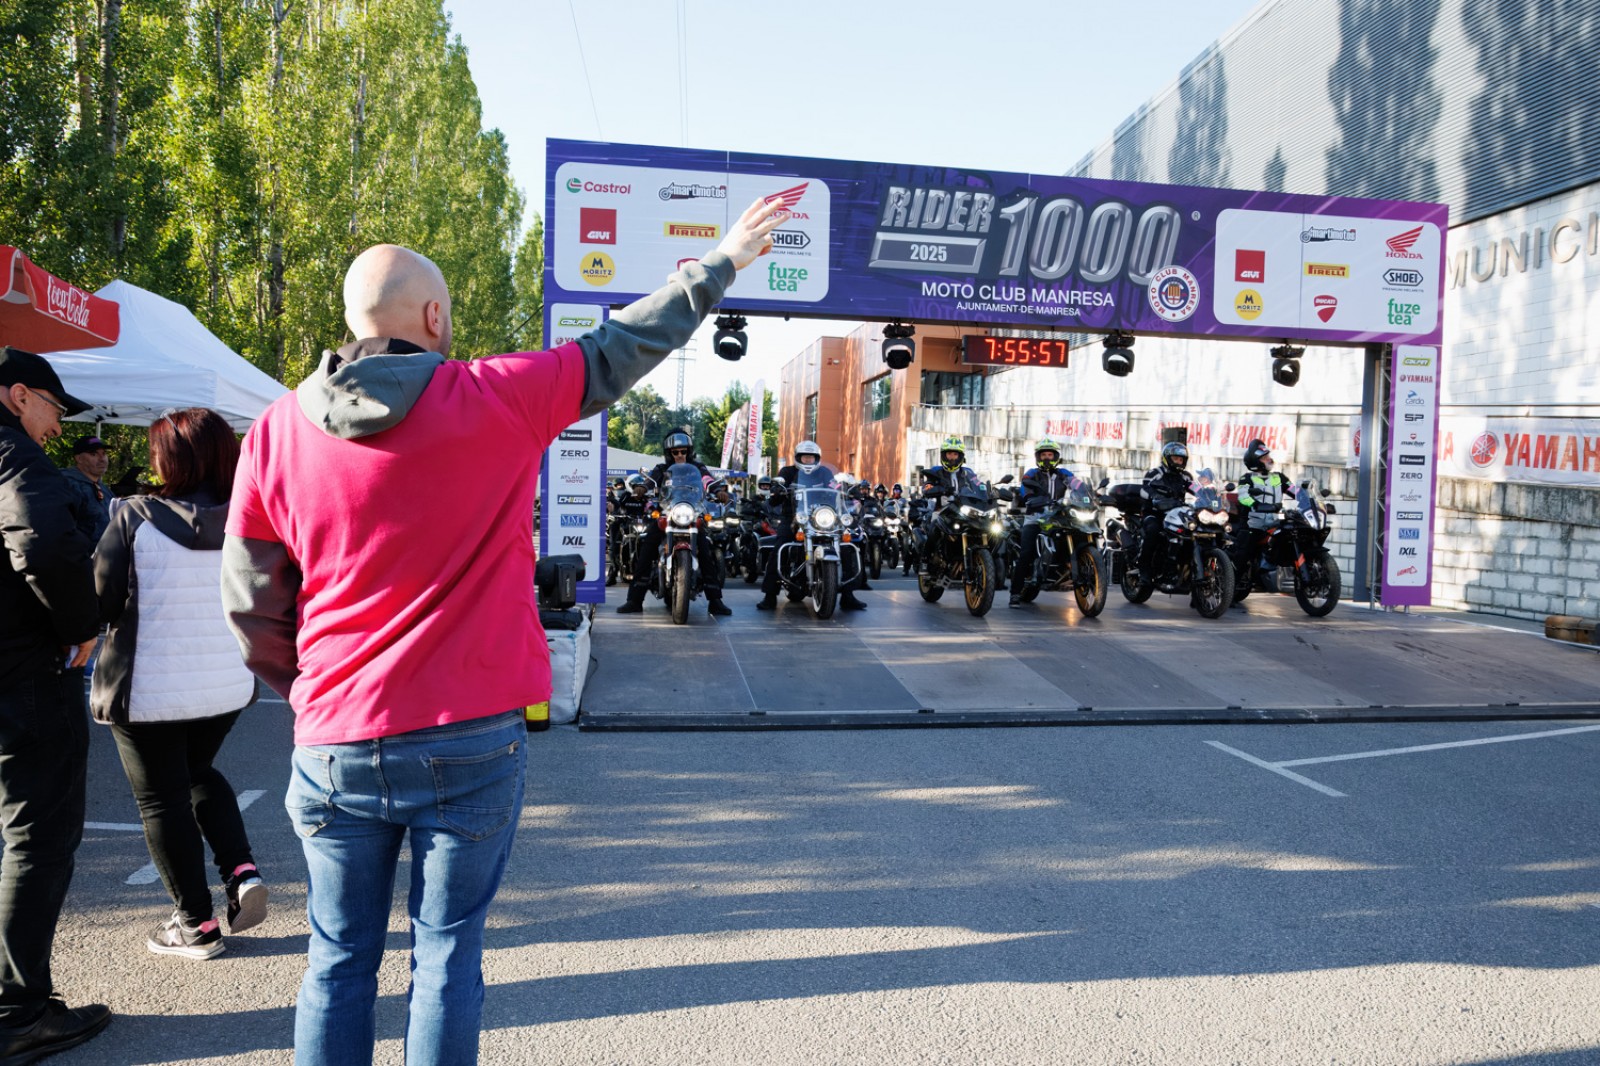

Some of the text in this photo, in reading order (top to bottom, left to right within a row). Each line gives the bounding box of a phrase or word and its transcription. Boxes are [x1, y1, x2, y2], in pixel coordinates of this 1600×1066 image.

[584, 180, 631, 195] Castrol
[671, 183, 727, 199] martimotos
[881, 186, 996, 233] RIDER
[587, 230, 611, 240] GIVI
[669, 224, 716, 238] PIRELLI
[999, 196, 1182, 286] 1000
[910, 244, 947, 262] 2025
[1385, 251, 1424, 260] HONDA
[583, 268, 612, 276] MORITZ
[768, 262, 808, 281] fuze
[1155, 268, 1178, 282] CLUB
[1240, 270, 1260, 279] GIVI
[1308, 264, 1346, 277] PIRELLI
[1389, 272, 1418, 284] SHOEI
[768, 279, 798, 292] tea
[922, 281, 1115, 307] MOTO CLUB MANRESA
[1388, 298, 1420, 315] fuze
[1388, 313, 1412, 325] tea
[984, 338, 1066, 364] 7:55:57
[1406, 374, 1433, 383] YAMAHA
[749, 404, 758, 443] YAMAHA
[1404, 413, 1424, 422] SP
[560, 449, 590, 458] ZERO
[1400, 472, 1423, 480] ZERO
[562, 535, 586, 546] IXIL
[1398, 547, 1418, 556] IXIL
